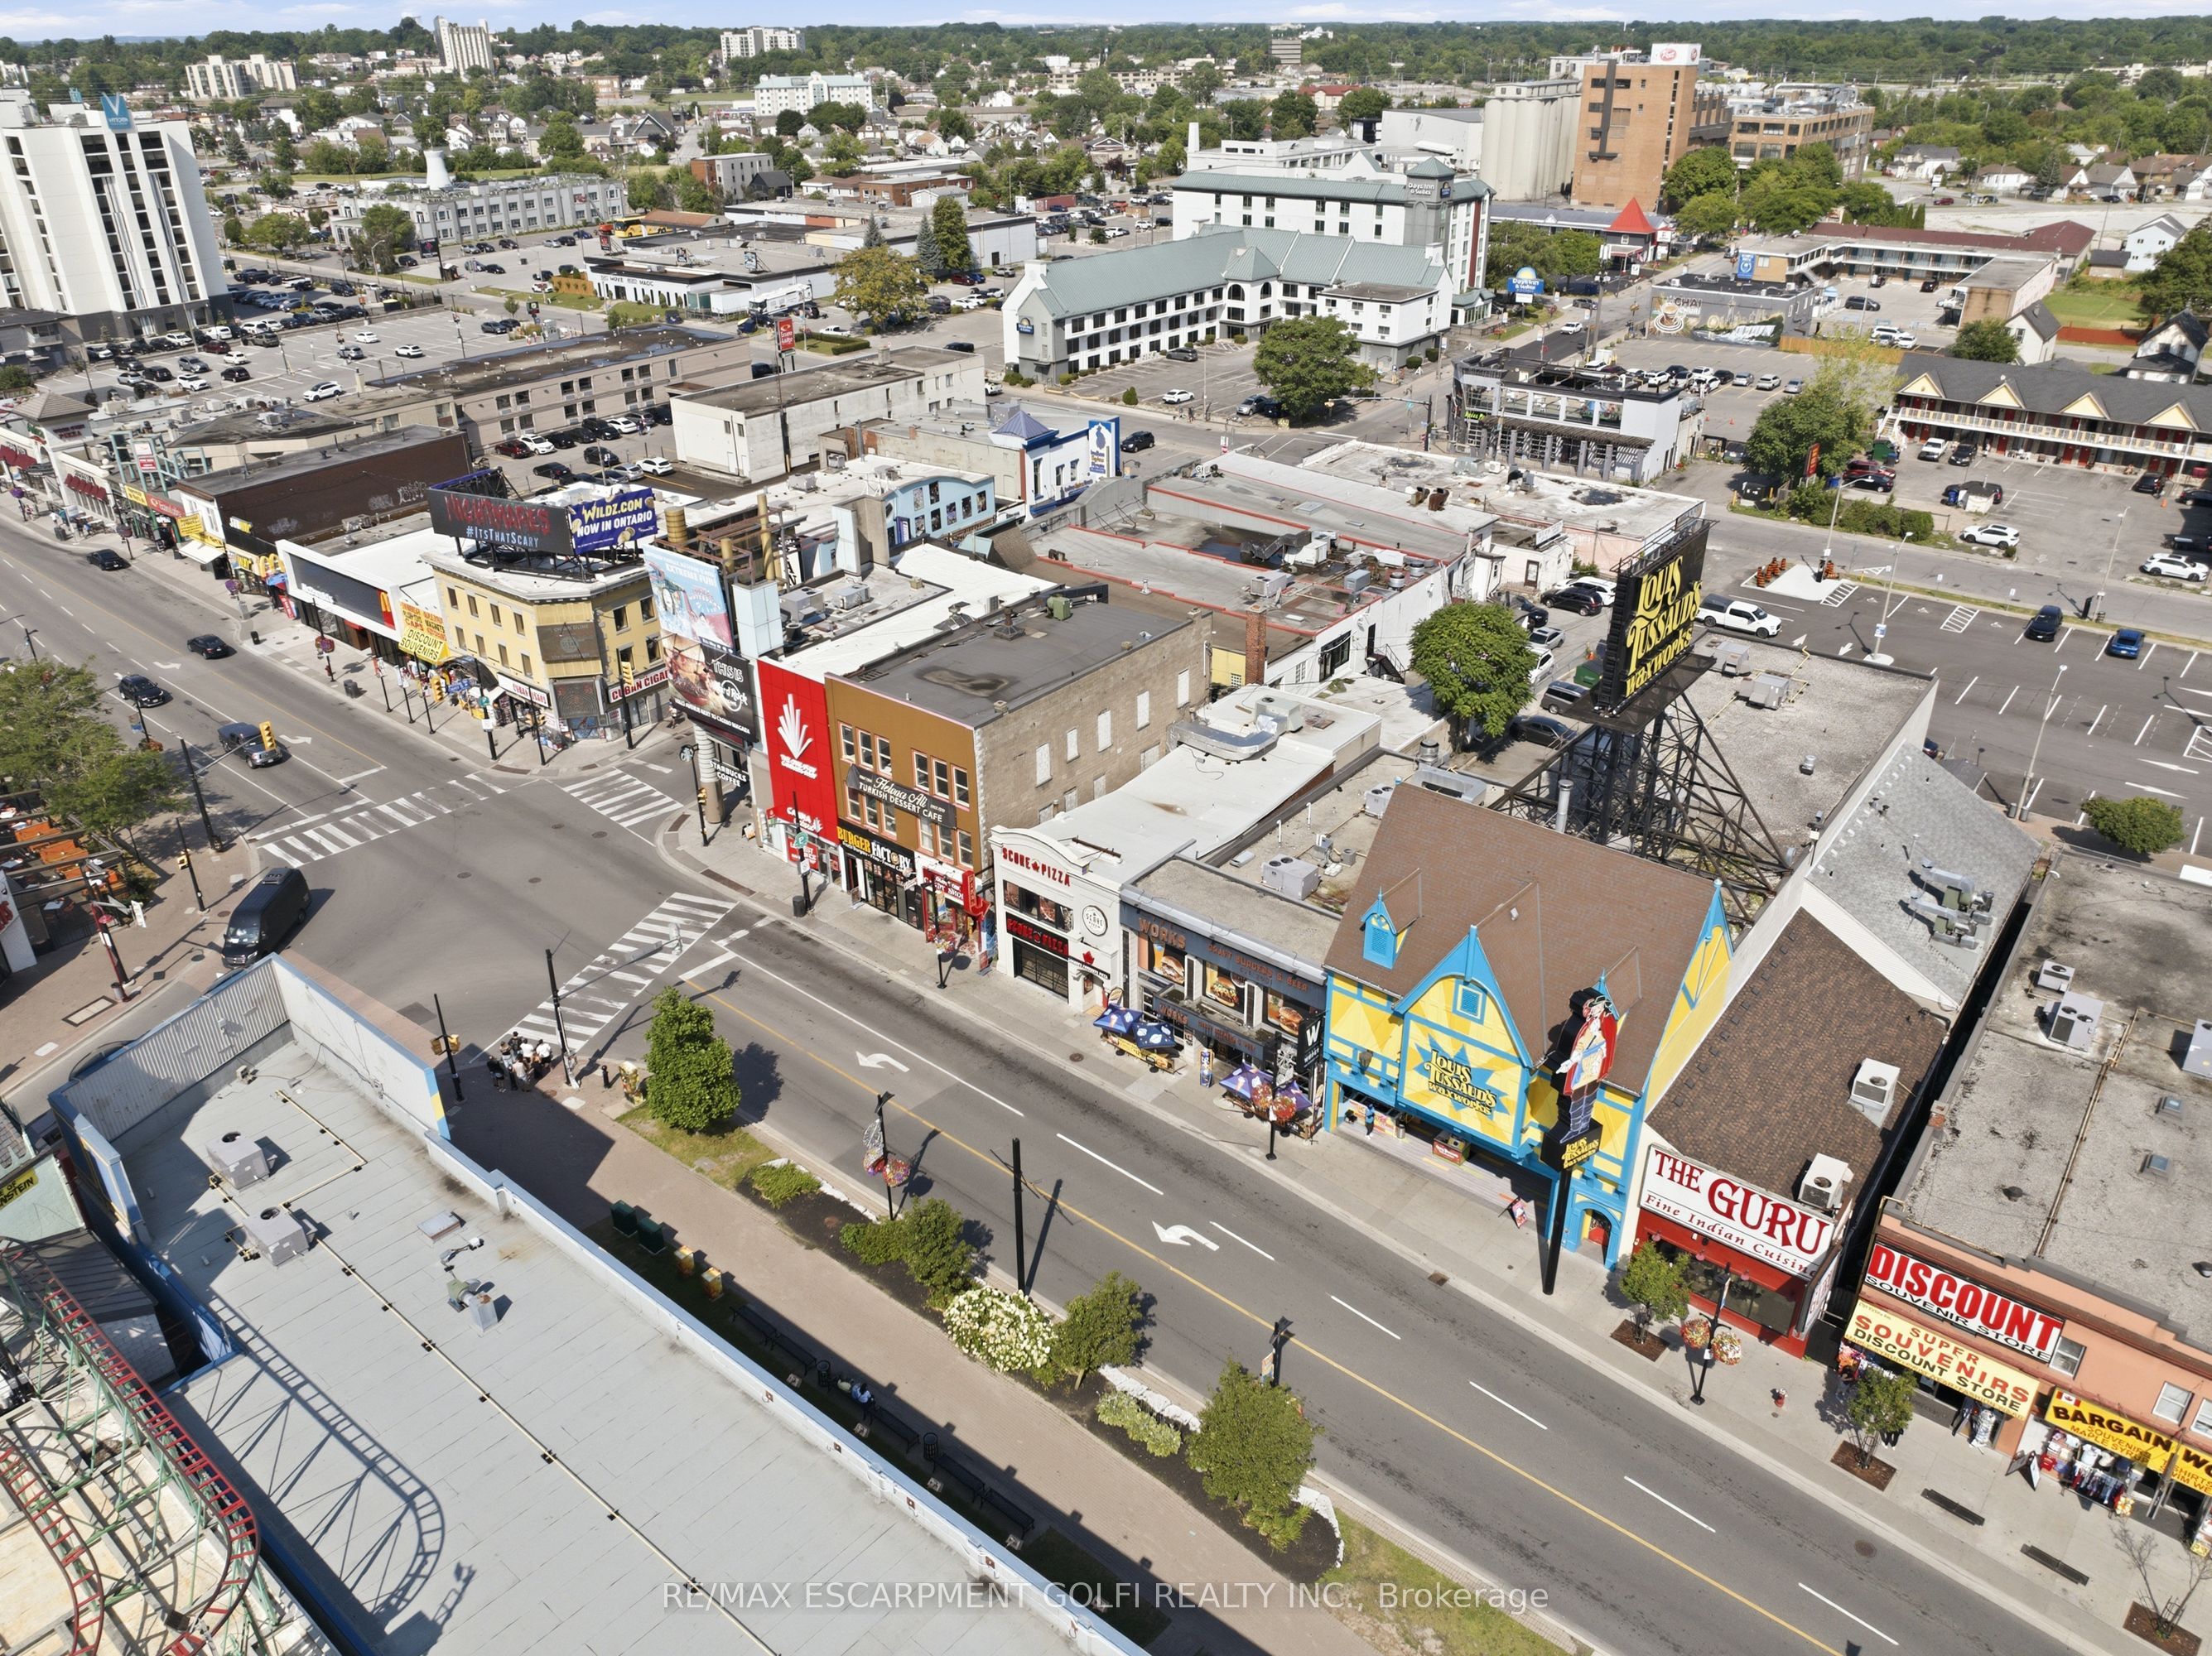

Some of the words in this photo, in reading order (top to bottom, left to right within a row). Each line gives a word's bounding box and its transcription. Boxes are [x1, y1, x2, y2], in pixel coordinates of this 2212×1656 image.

[1675, 298, 1702, 308] CHAI
[577, 522, 600, 537] NOW
[601, 520, 612, 532] IN
[614, 510, 653, 529] ONTARIO
[582, 498, 643, 523] WILDZ.COM
[1637, 556, 1684, 620] LOUIS
[401, 637, 439, 661] SOUVENIRS
[407, 629, 443, 649] DISCOUNT
[612, 679, 643, 700] CUBAN
[710, 760, 747, 782] STARBUCKS
[716, 771, 741, 787] COFFEE
[859, 782, 887, 802] TURKISH
[889, 796, 920, 814] DESSERT
[923, 809, 942, 822] CAFE
[836, 826, 871, 853] BURGER
[1002, 848, 1031, 869] SCORE
[1041, 864, 1071, 887] PIZZA
[1007, 918, 1033, 940] SCORE
[1042, 932, 1068, 956] PIZZA
[1139, 917, 1186, 950] WORKS
[1306, 1020, 1321, 1047] W
[1424, 1061, 1497, 1108] TUSSAUD'S
[1432, 1049, 1472, 1083] LOUIS
[1645, 1194, 1680, 1216] Fine
[1688, 1212, 1745, 1245] Indian
[1655, 1149, 1705, 1194] THE
[1708, 1177, 1830, 1256] GURU
[1867, 1245, 2064, 1352] DISCOUNT
[1865, 1275, 1969, 1326] SOUVENIR
[1978, 1324, 2051, 1361] STORE
[1855, 1314, 2029, 1403] SOUVENIRS
[1910, 1326, 1979, 1365] SUPER
[1853, 1327, 1948, 1378] DISCOUNT
[1956, 1375, 2022, 1412] STORE
[2053, 1406, 2173, 1452] BARGAIN
[2070, 1425, 2108, 1447] MAPLE
[2111, 1444, 2151, 1464] SYRUP
[2087, 1424, 2152, 1458] SOUVENIRS
